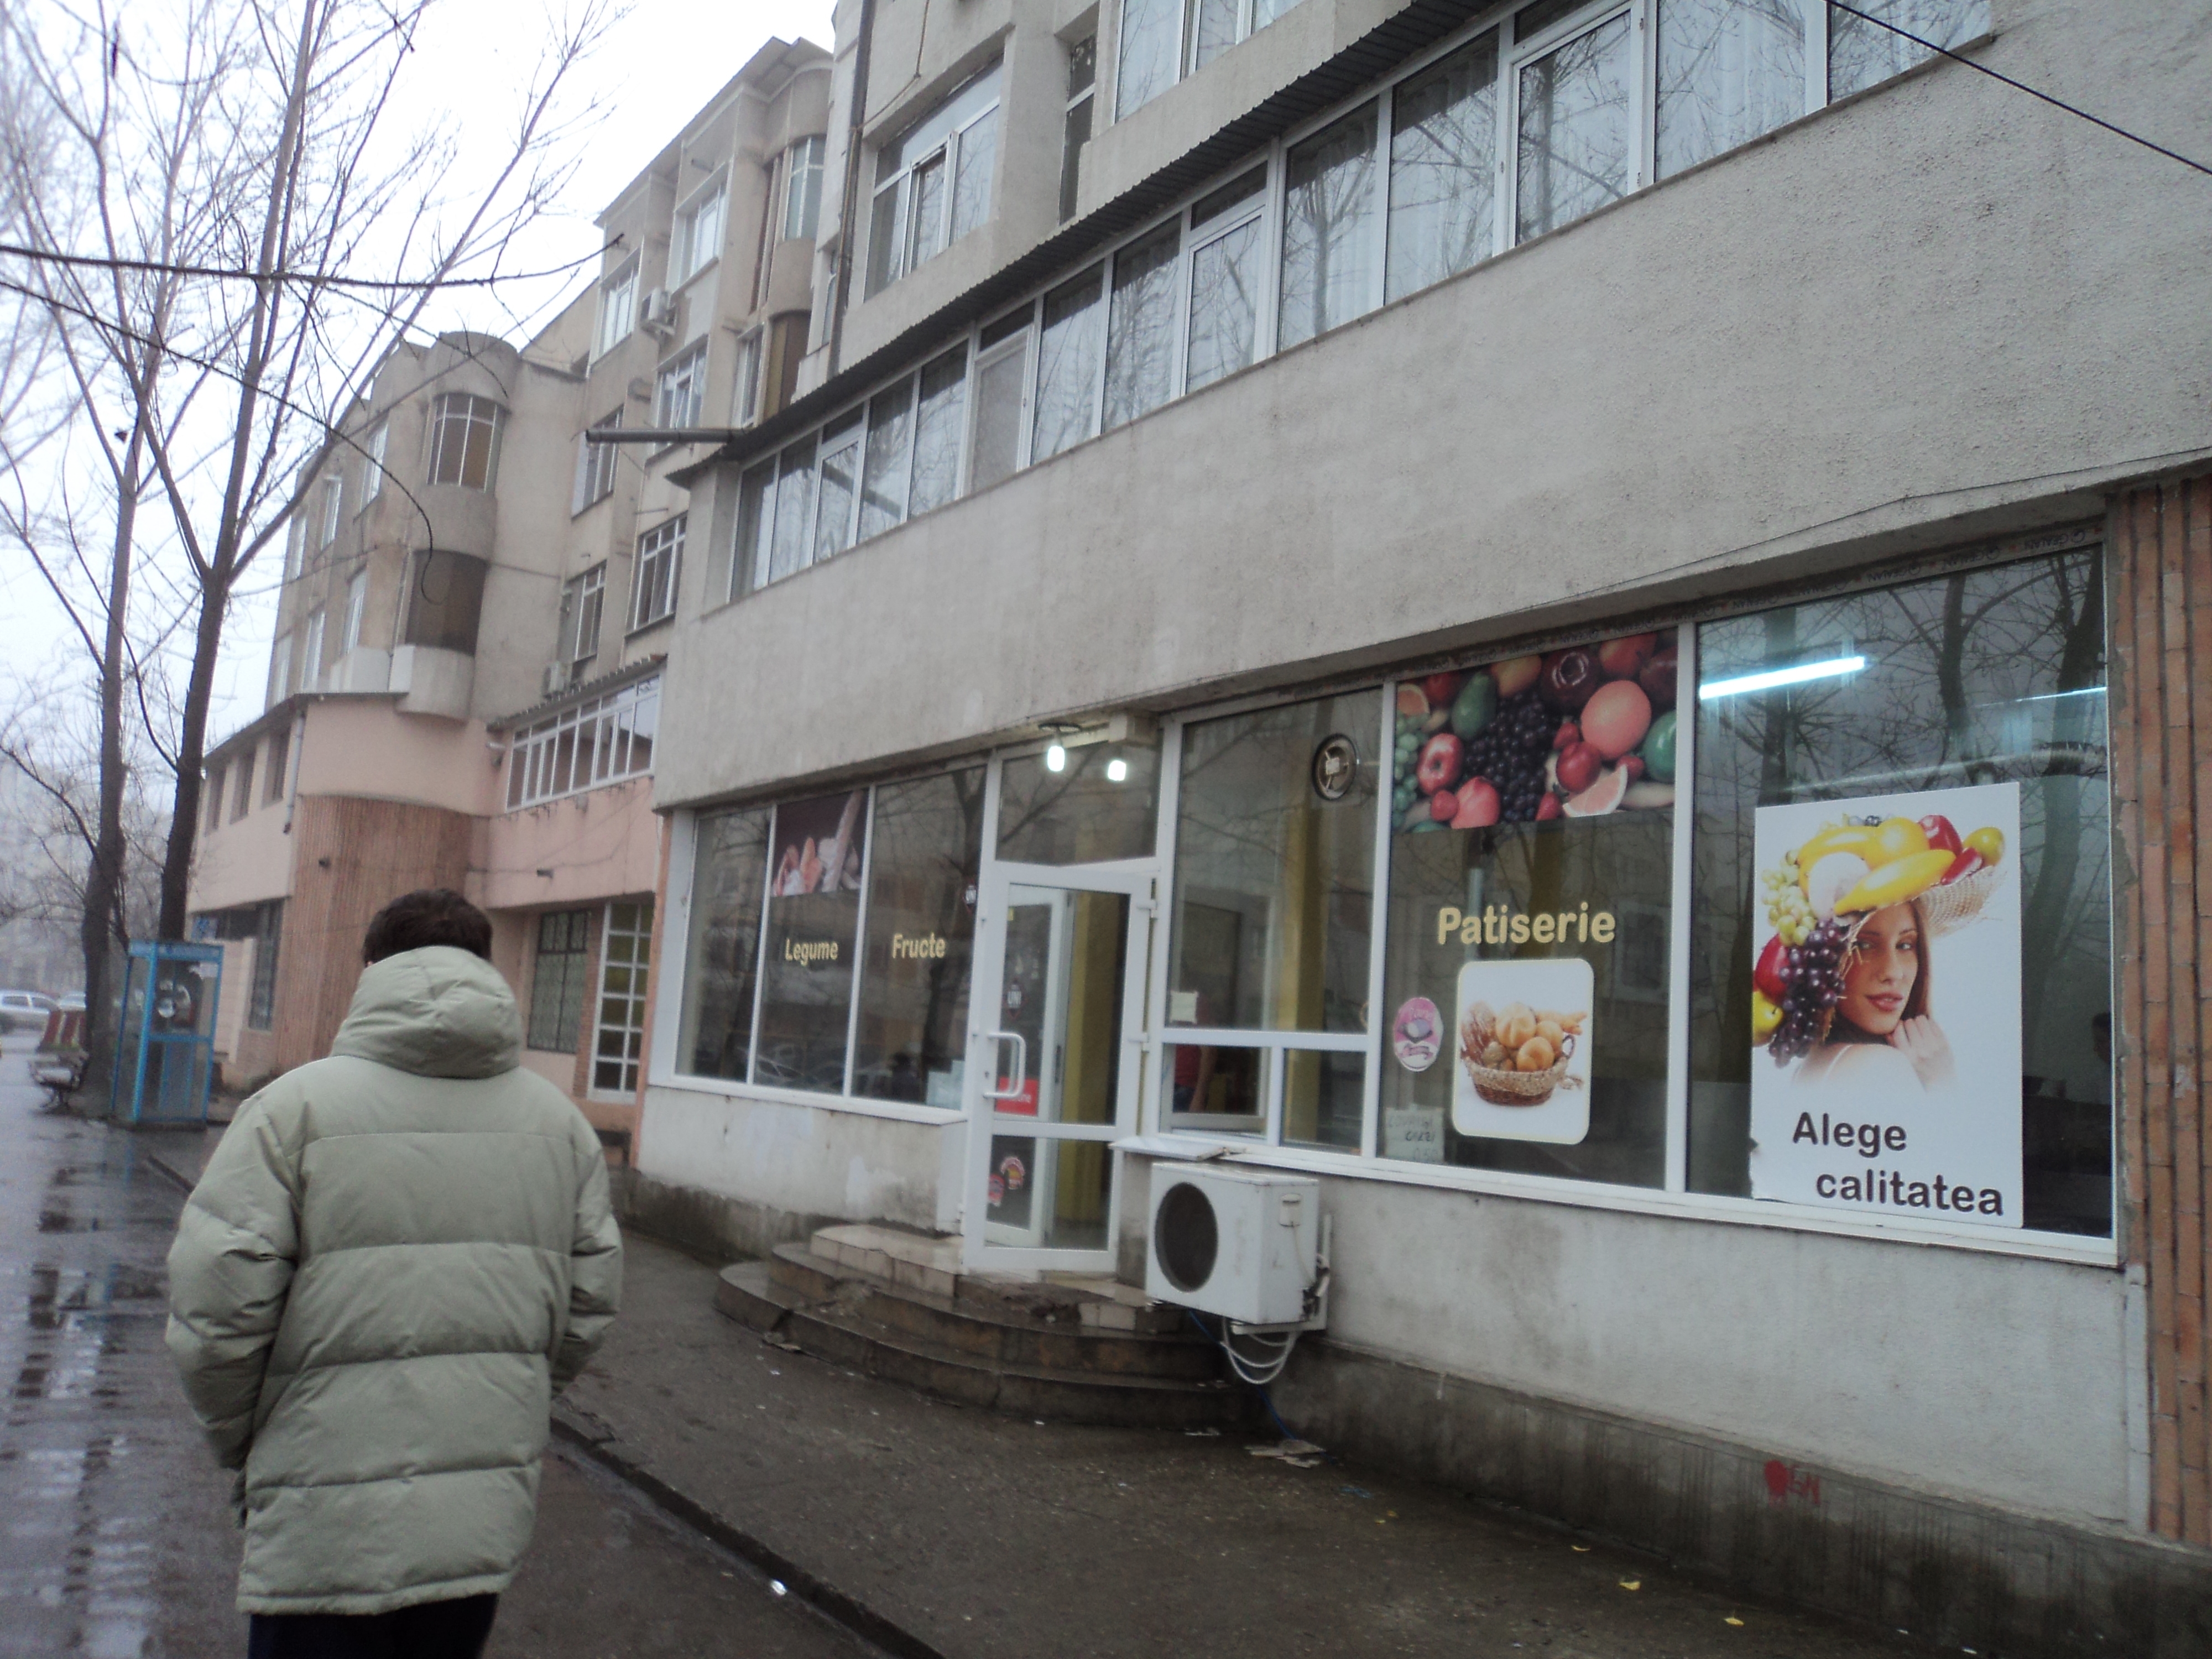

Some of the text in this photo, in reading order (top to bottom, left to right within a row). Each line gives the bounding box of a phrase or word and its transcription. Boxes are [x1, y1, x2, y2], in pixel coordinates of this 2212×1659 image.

[2024, 533, 2068, 551] GEALAN
[1867, 567, 1907, 582] GEALAN
[1438, 901, 1616, 945] Patiserie
[785, 938, 838, 967] Legume
[892, 932, 946, 959] Fructe
[1793, 1112, 1907, 1158] Alege
[1816, 1168, 2004, 1217] calitatea
